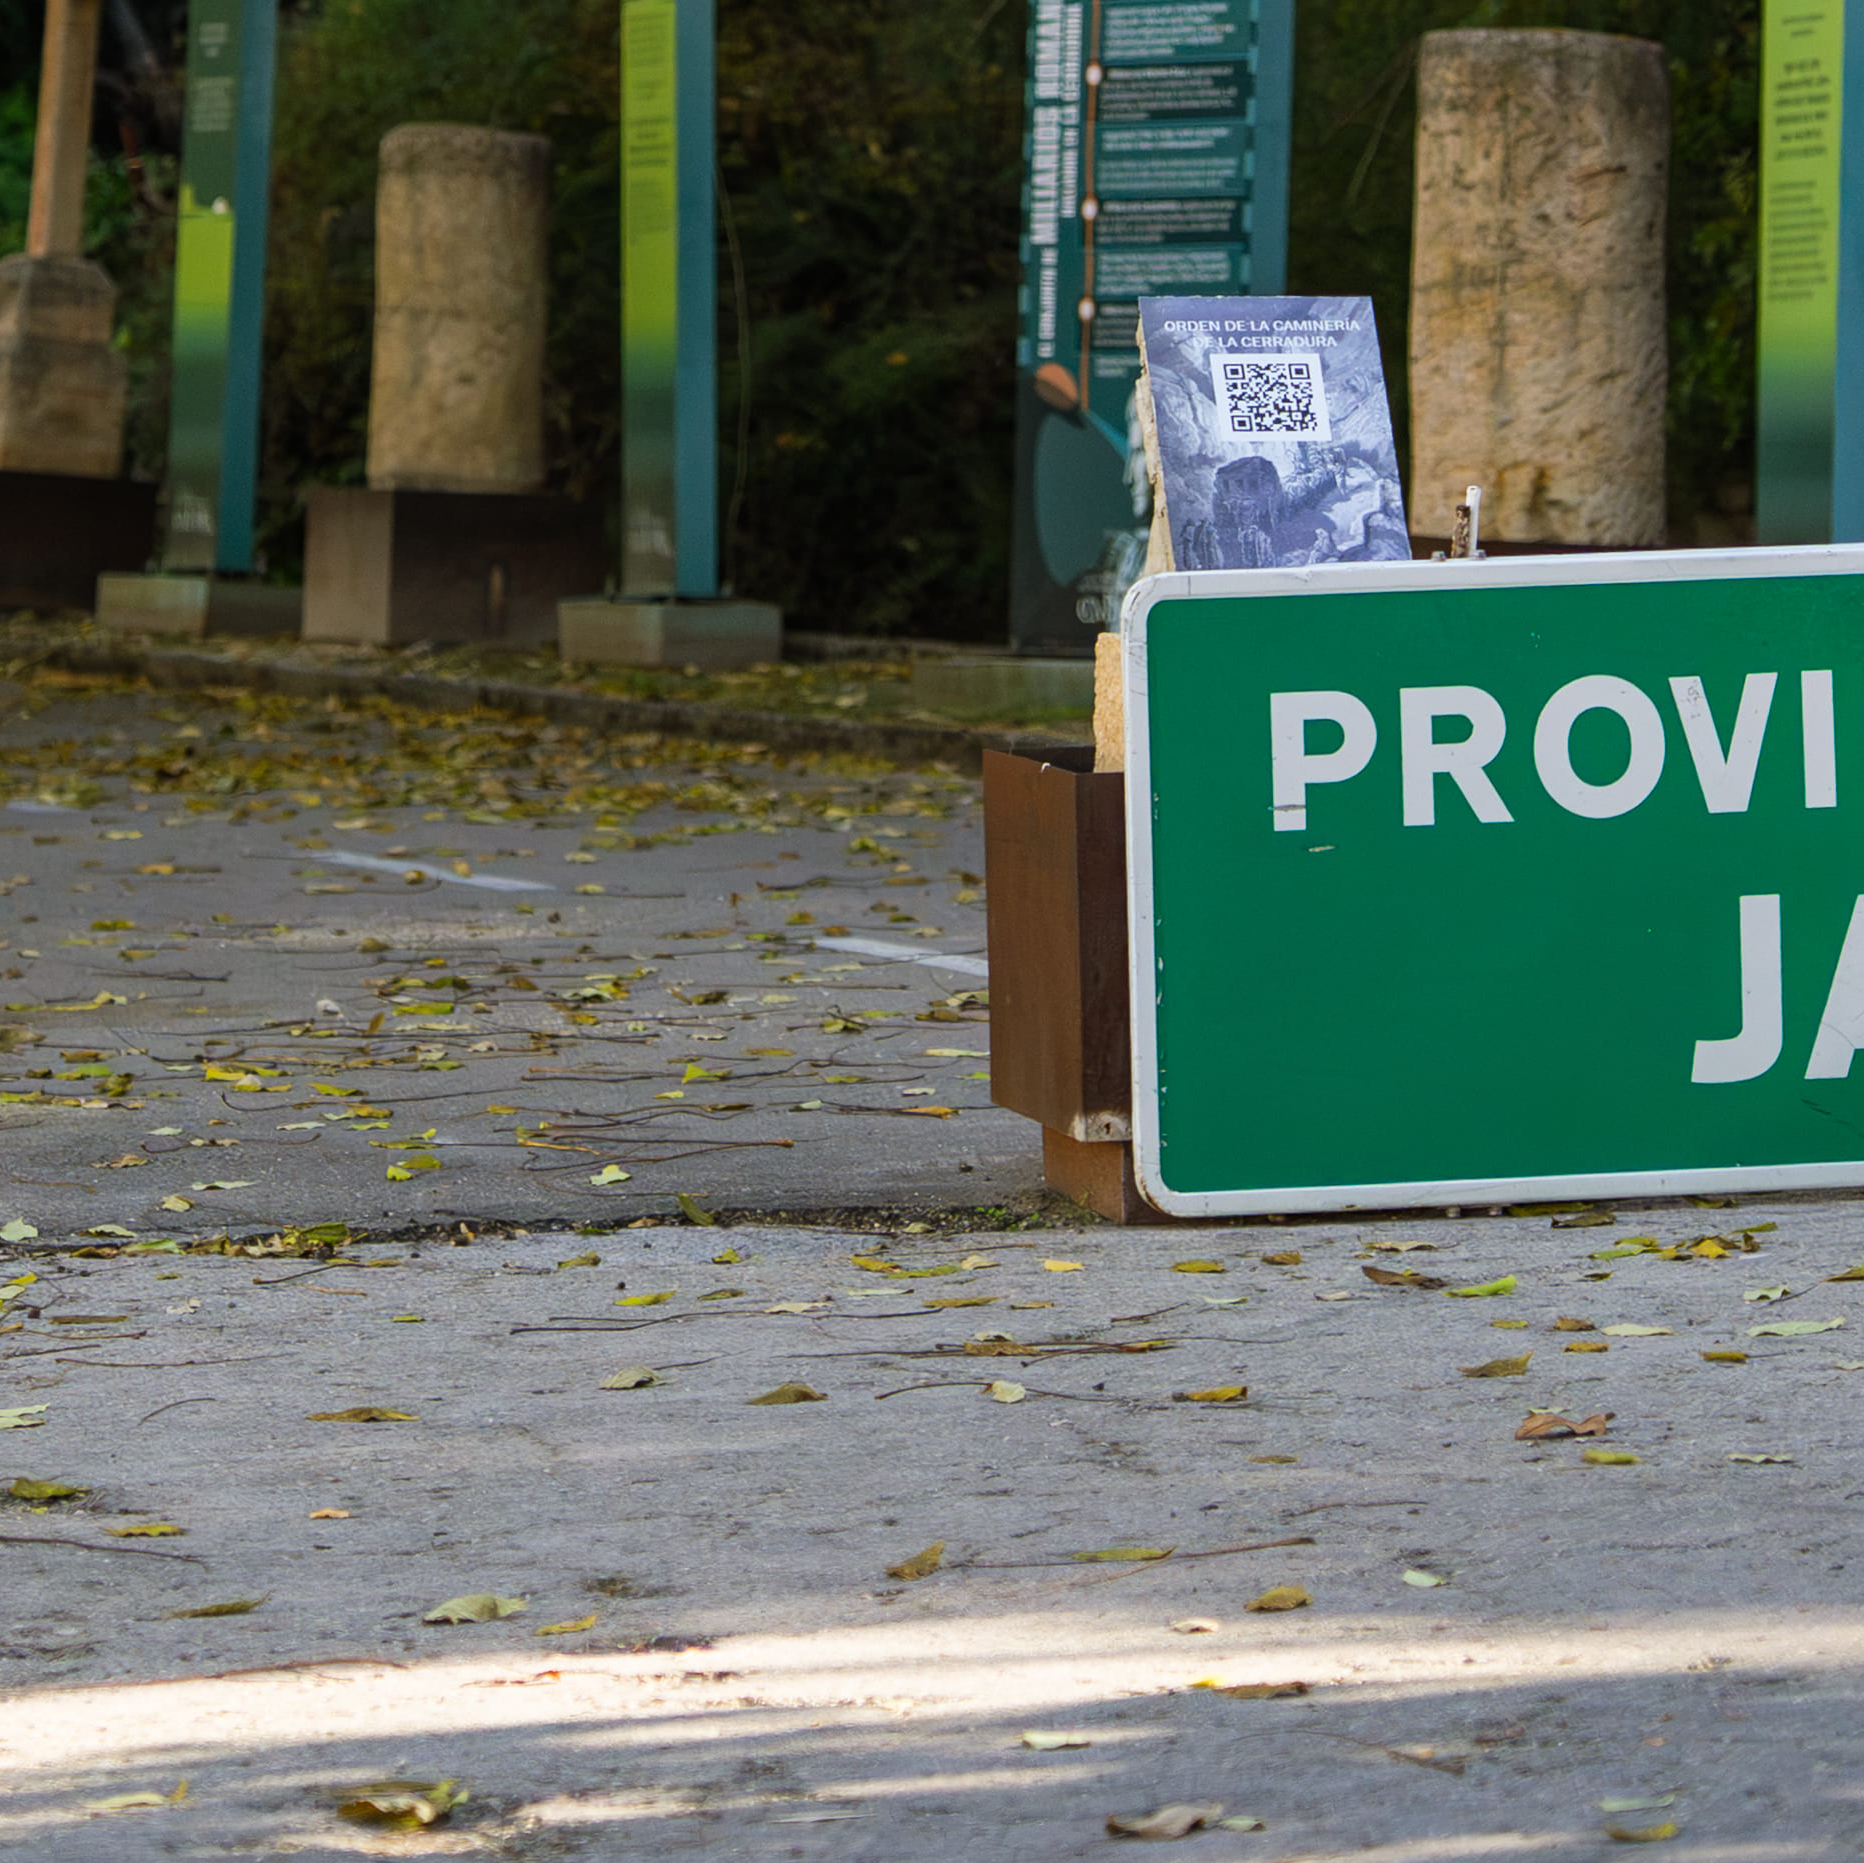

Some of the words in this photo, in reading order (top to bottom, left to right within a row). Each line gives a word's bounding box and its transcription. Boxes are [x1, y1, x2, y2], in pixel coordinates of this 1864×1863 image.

[1029, 106, 1059, 246] MILIARIOS
[1164, 320, 1220, 332] ORDEN
[1225, 320, 1246, 332] DE
[1248, 320, 1270, 332] LA
[1272, 317, 1361, 332] CAMINERÍA
[1218, 336, 1239, 348] LA
[1241, 336, 1337, 348] CERRADURA
